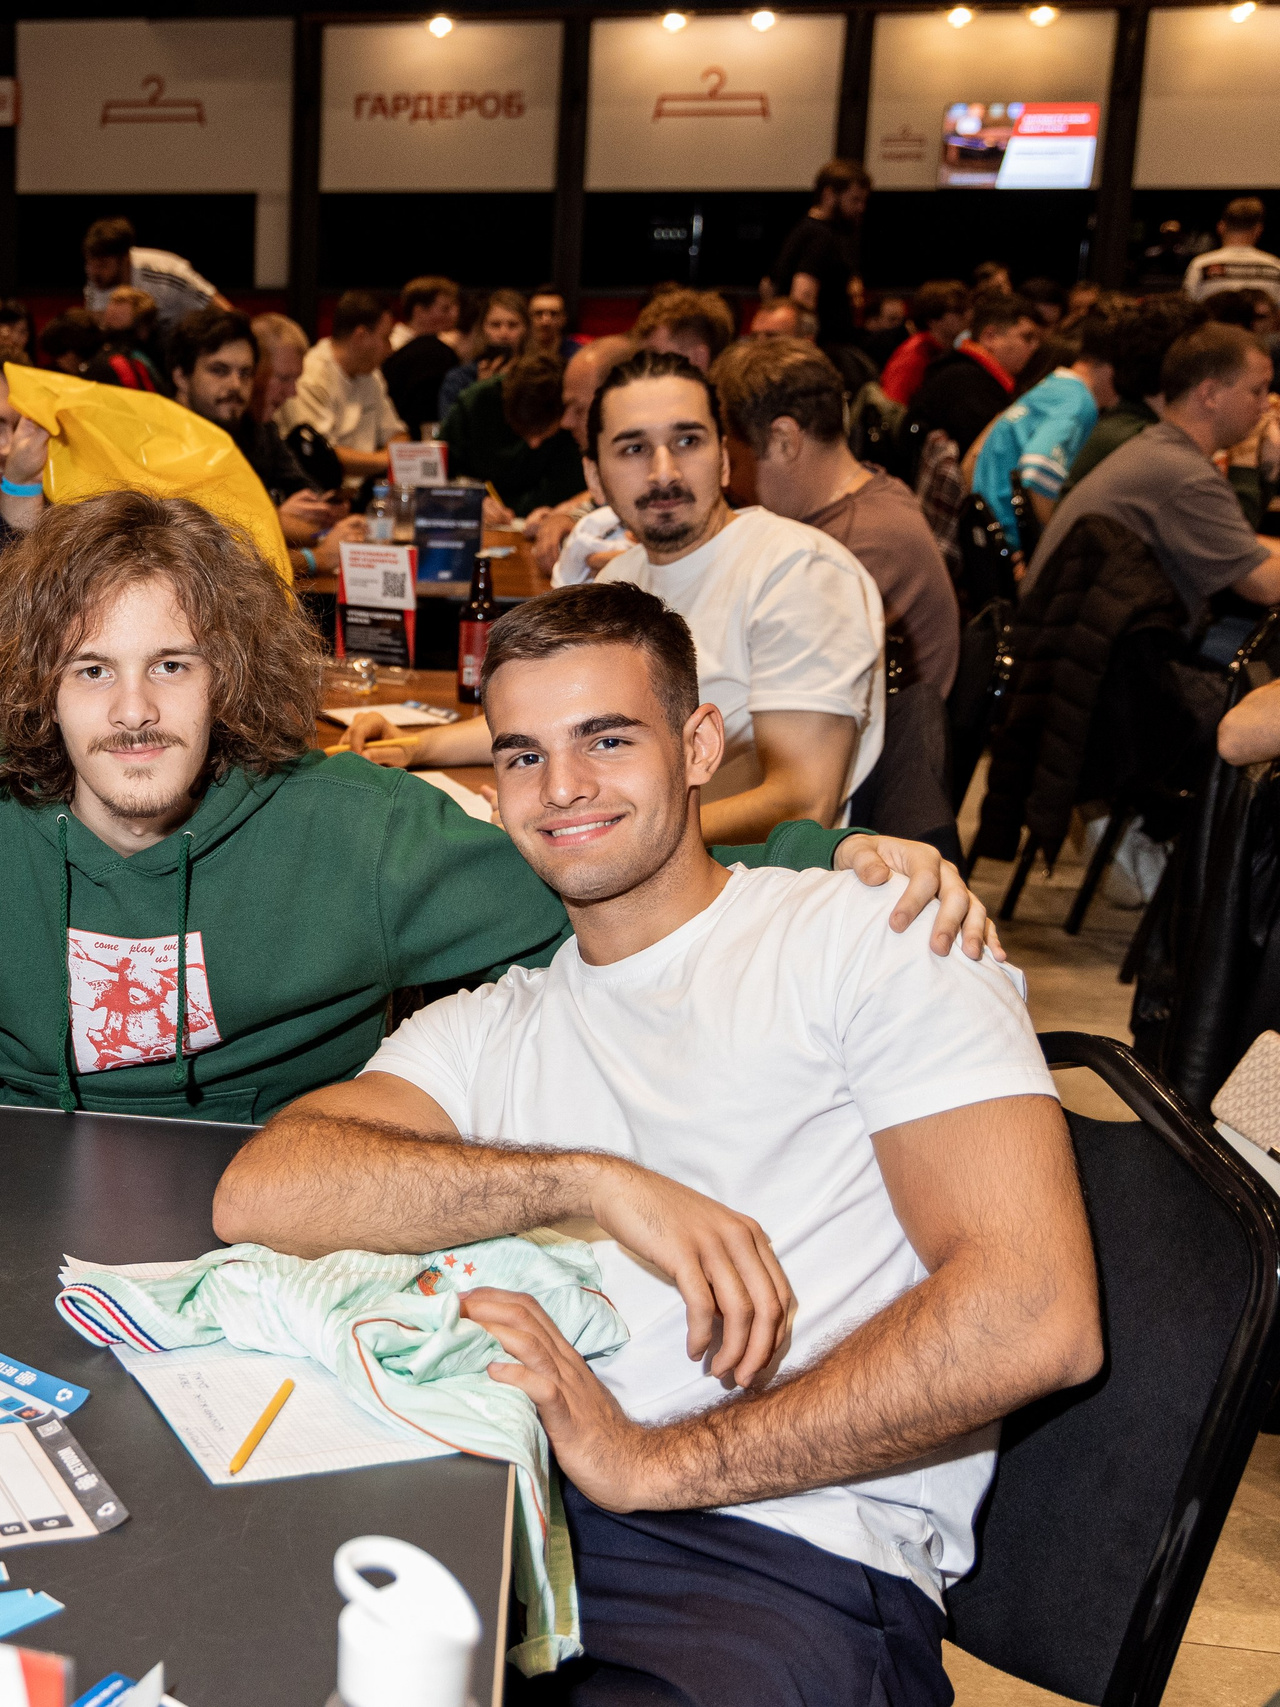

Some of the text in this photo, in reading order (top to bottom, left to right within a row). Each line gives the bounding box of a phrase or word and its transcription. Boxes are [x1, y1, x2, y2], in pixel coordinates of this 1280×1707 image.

[354, 91, 526, 125] ГАРДЕРОБ
[94, 941, 120, 951] come
[129, 943, 156, 956] play
[57, 1446, 88, 1477] BETBOOM
[3, 1525, 20, 1534] 5
[43, 1518, 60, 1528] 6
